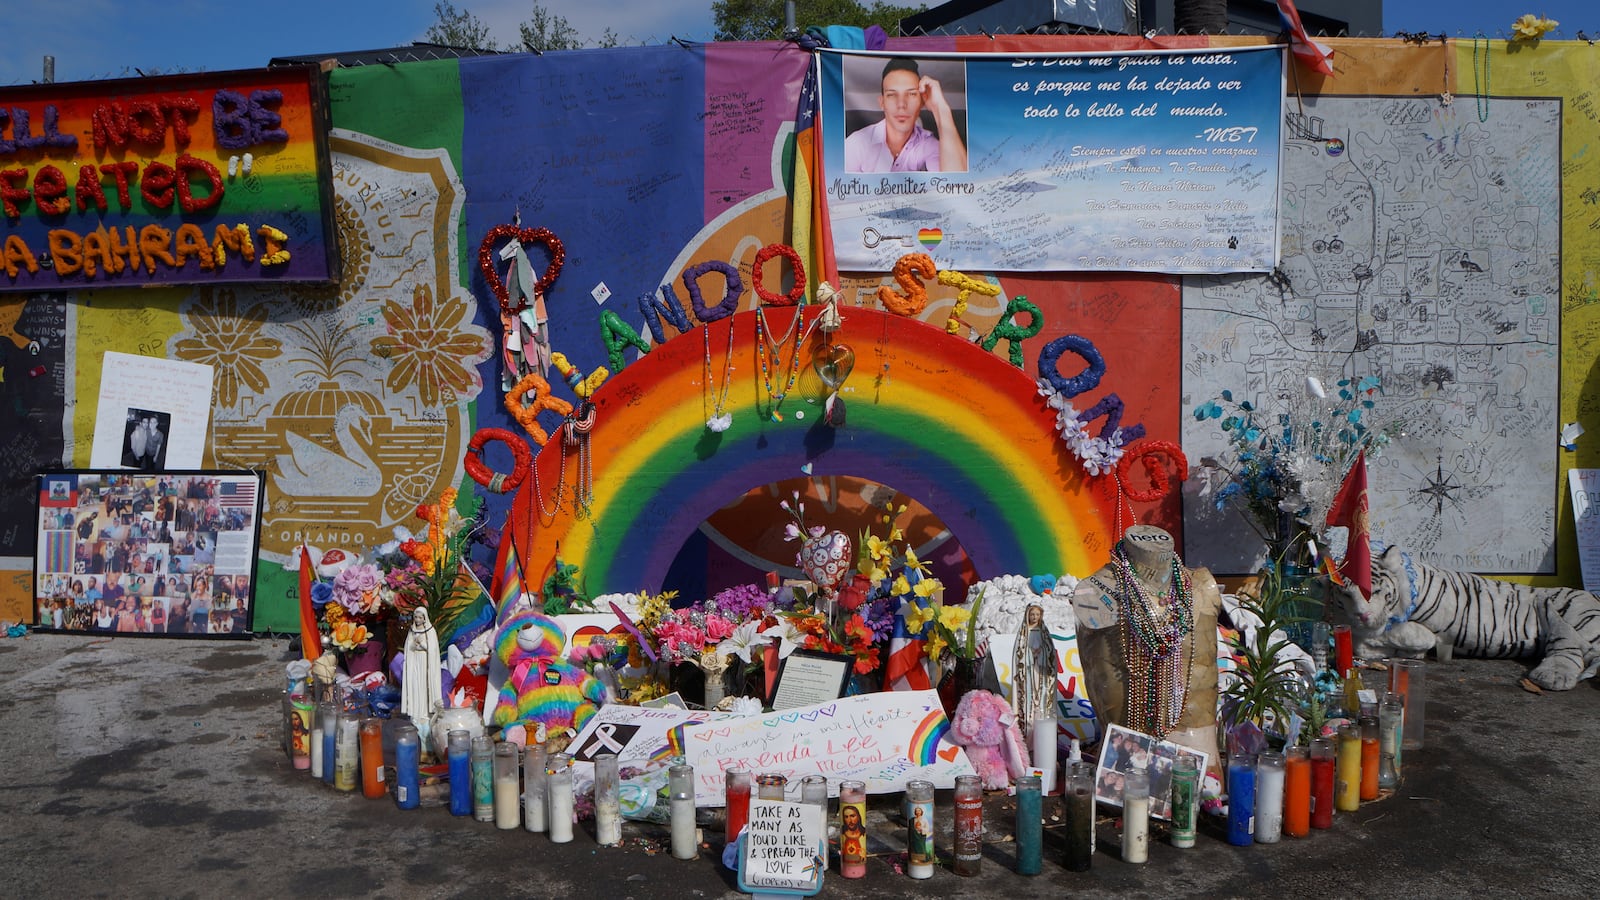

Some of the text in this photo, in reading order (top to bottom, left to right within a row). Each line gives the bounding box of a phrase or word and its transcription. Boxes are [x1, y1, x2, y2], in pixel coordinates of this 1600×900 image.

[1089, 56, 1112, 66] me
[1013, 75, 1242, 96] es porque me ha dejado ver
[1024, 102, 1228, 118] todo lo bello del mundo.
[92, 97, 200, 149] NOT
[212, 88, 289, 149] BE
[1071, 146, 1116, 157] Siempre
[1151, 148, 1162, 156] en
[1166, 147, 1208, 156] nuestros
[1212, 147, 1258, 159] corazones
[930, 177, 975, 195] Torres
[48, 222, 291, 278] BAHRAMI
[280, 530, 364, 544] ORLANDO
[1130, 533, 1169, 544] hero
[636, 708, 678, 721] June
[754, 806, 801, 818] TAKE AS
[751, 820, 803, 833] MANY AS
[752, 834, 807, 846] YOU'D LIKE
[750, 847, 815, 859] & SPREAD THE
